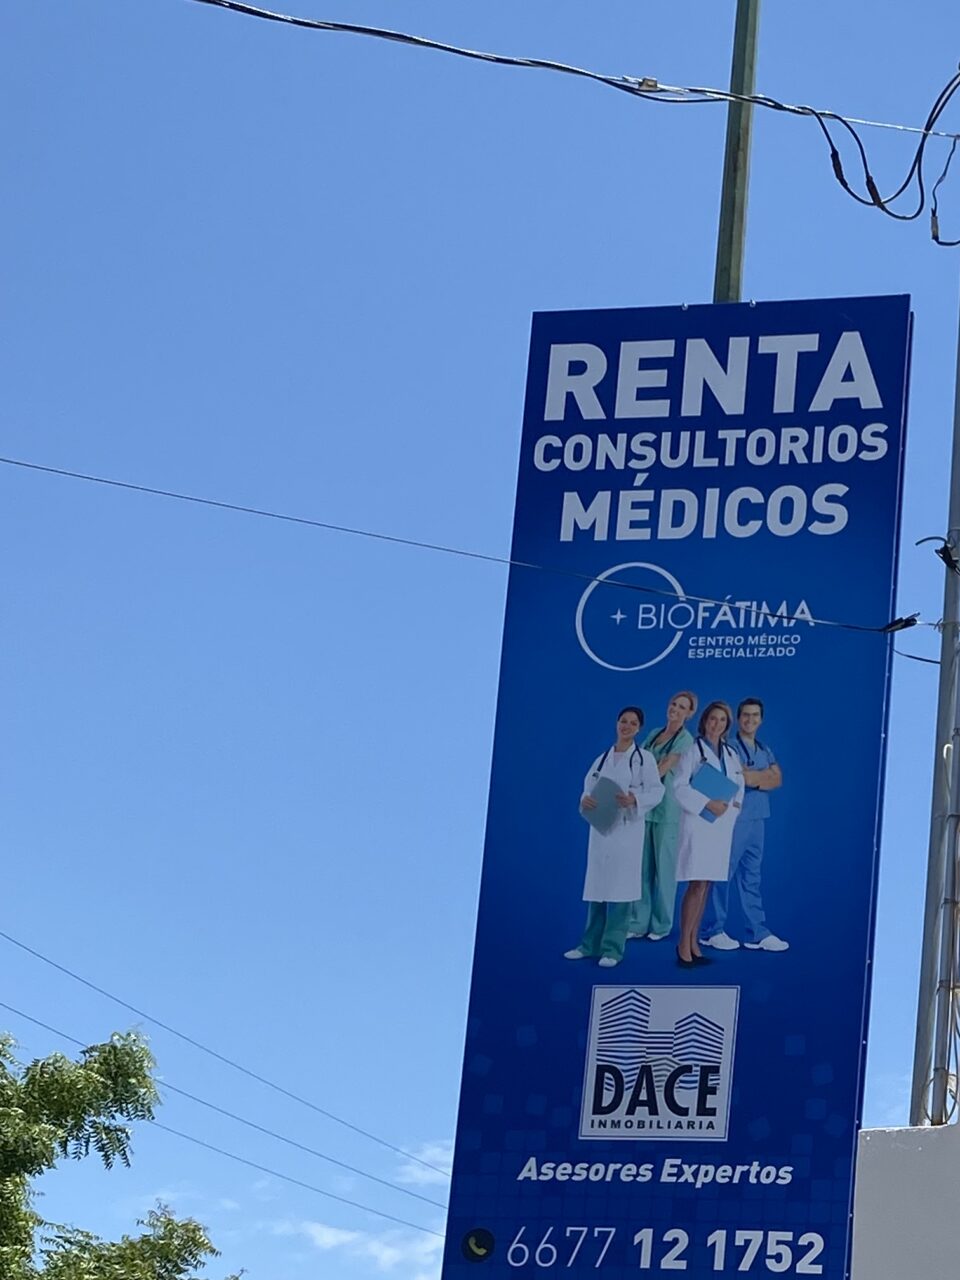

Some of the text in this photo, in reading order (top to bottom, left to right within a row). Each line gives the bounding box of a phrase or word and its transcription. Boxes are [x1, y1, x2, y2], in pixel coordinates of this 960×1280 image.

[543, 330, 884, 421] RENTA
[533, 423, 889, 472] CONSULTORIOS
[559, 473, 850, 541] MÉDICOS
[688, 633, 801, 647] CENTRO MÉDICO
[688, 646, 796, 659] ESPECIALIZADO
[591, 1064, 721, 1117] DACE
[590, 1119, 715, 1131] INMOBILIARIA
[517, 1157, 794, 1188] Asesores Expertos
[507, 1226, 825, 1275] 6677 12 1752
